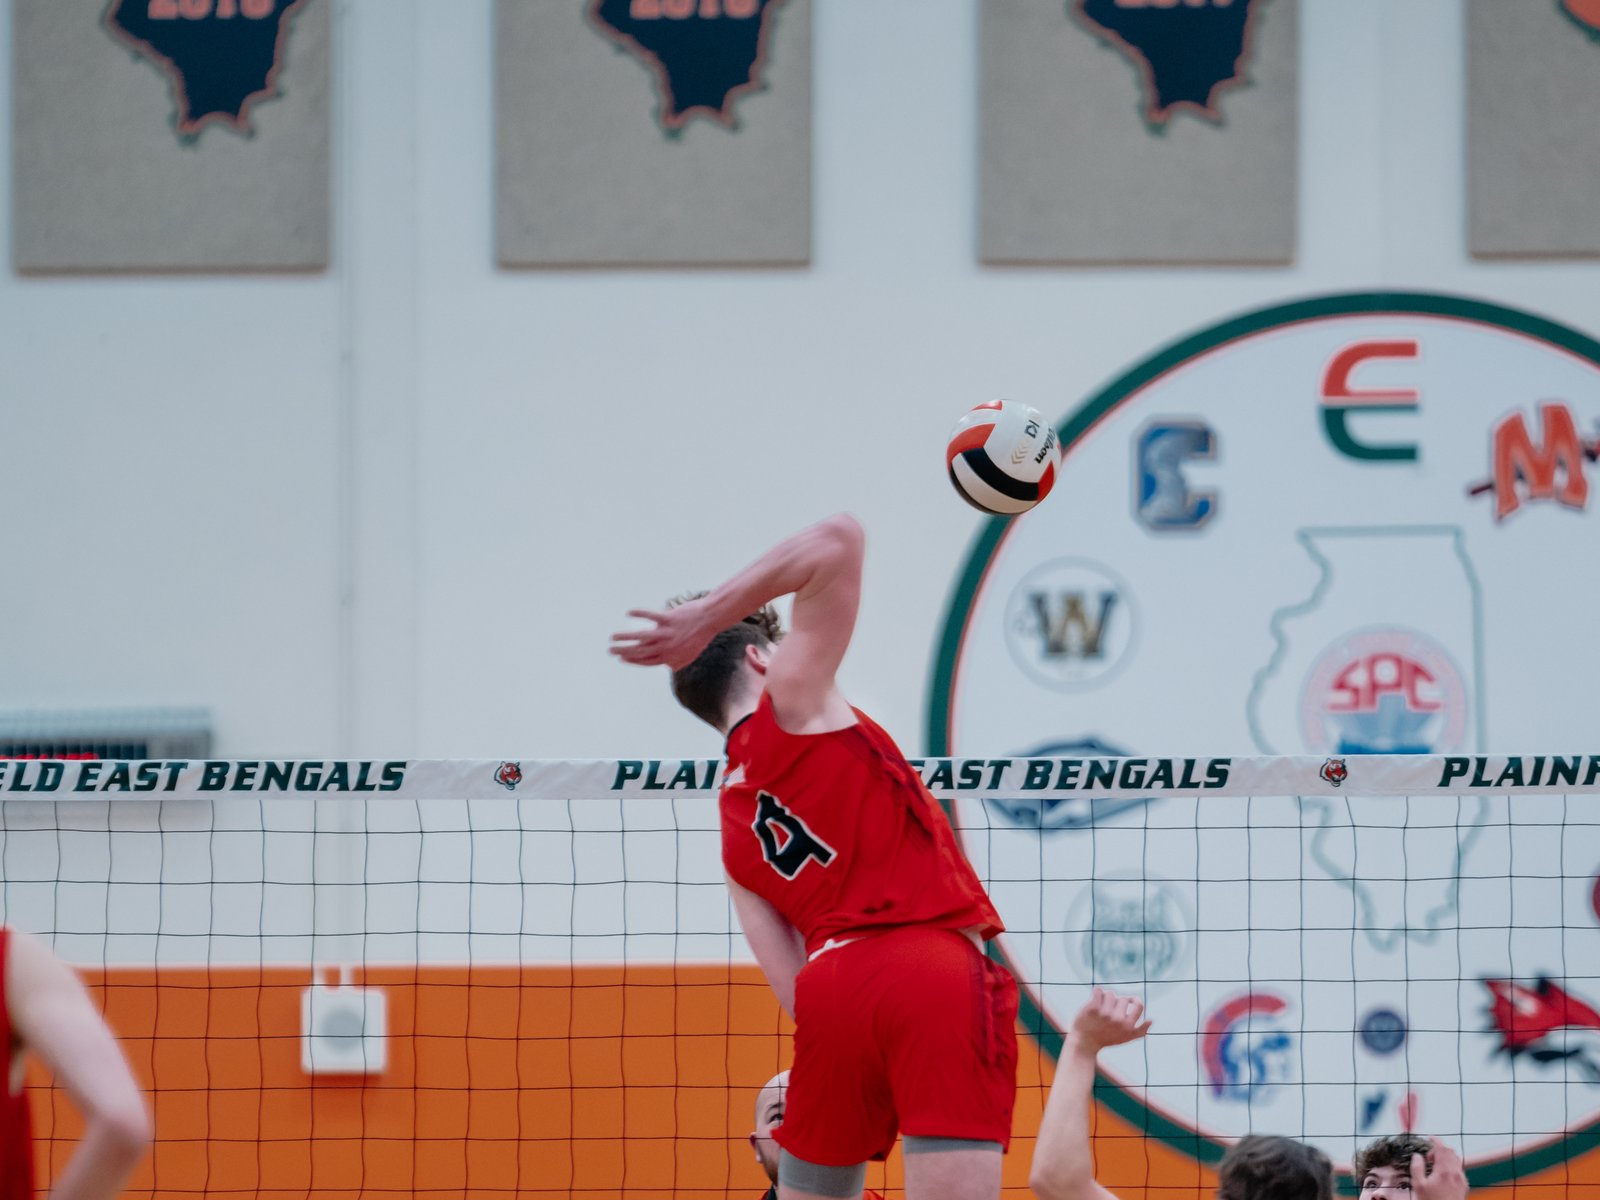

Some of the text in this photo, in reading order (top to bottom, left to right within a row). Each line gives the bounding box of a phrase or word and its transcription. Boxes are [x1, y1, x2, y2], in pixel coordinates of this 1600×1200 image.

[1326, 652, 1442, 713] SPC
[72, 761, 188, 791] EAST
[196, 761, 407, 792] BENGALS
[611, 760, 722, 790] PLAI
[1020, 758, 1231, 790] BENGALS
[752, 790, 838, 881] 4
